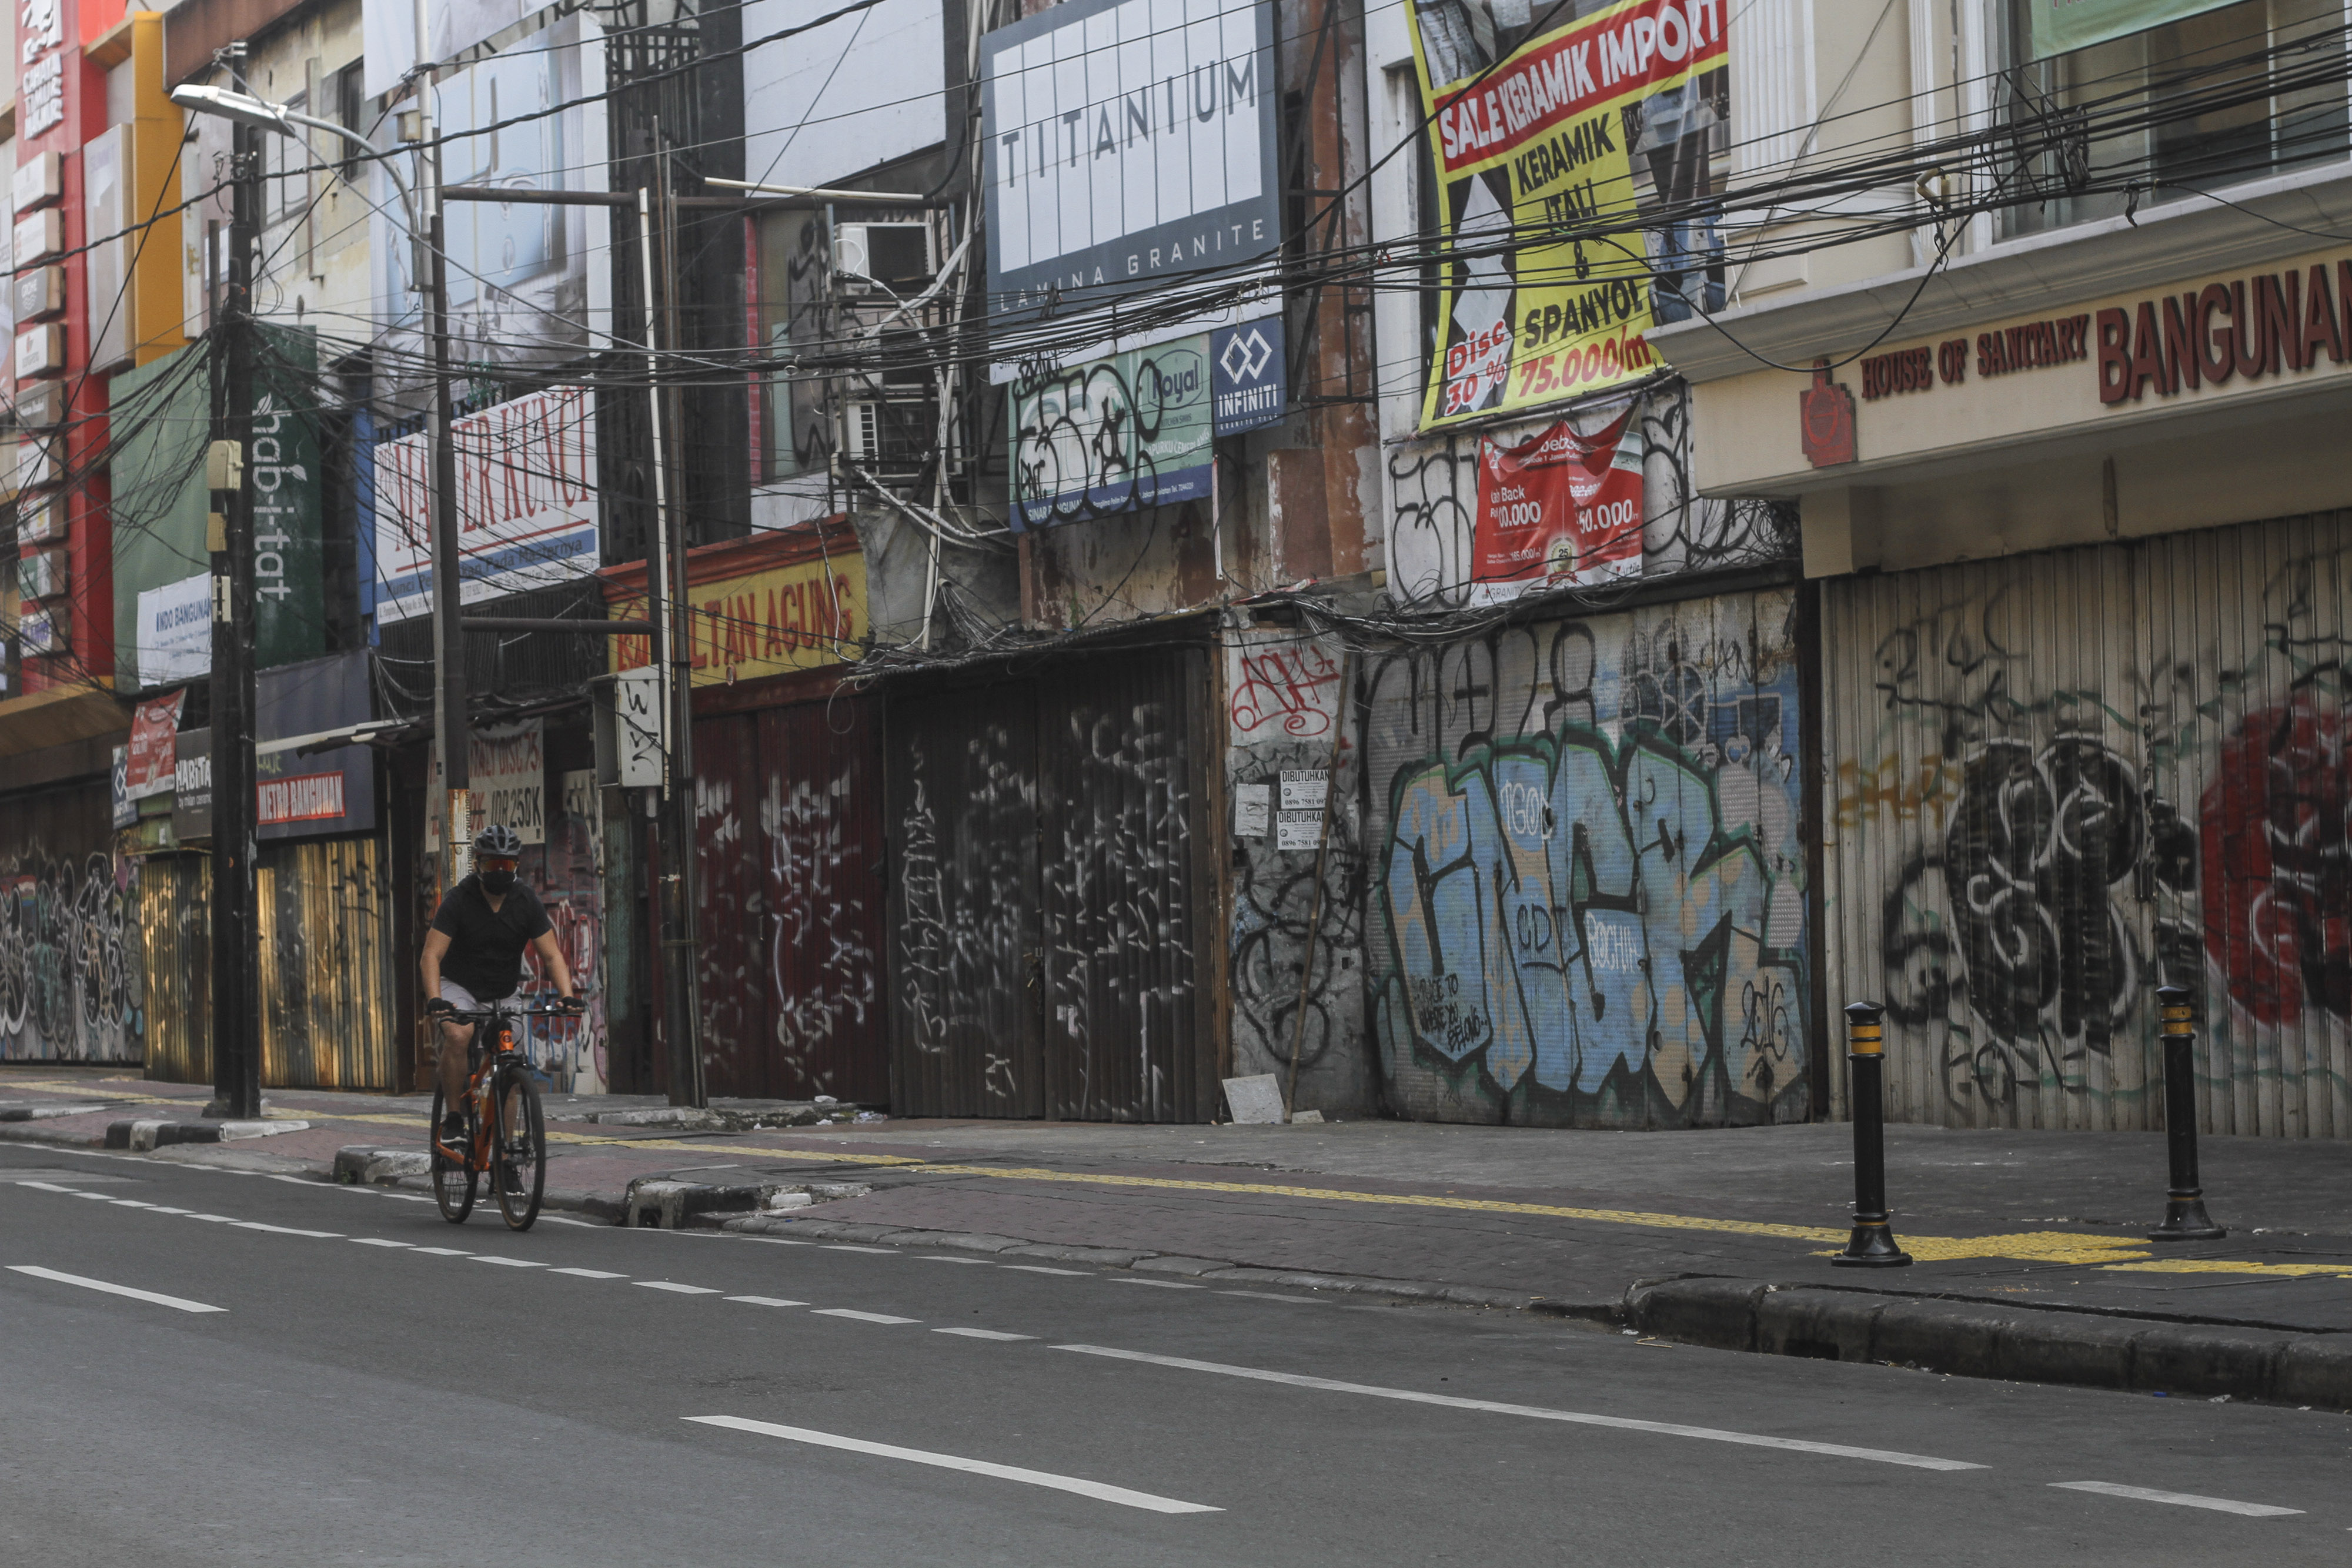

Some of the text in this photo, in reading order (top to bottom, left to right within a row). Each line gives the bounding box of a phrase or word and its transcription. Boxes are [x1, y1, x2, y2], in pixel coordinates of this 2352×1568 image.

[1440, 0, 1720, 160] SALE KERAMIK IMPORT
[1002, 48, 1255, 188] TITANIUM
[1514, 112, 1616, 196] KERAMIK
[999, 266, 1105, 312] LAMINA
[1127, 219, 1264, 275] GRANITE
[1524, 279, 1645, 349] SPANYOL
[1152, 359, 1198, 403] Royal
[1860, 346, 1933, 401] HOUSE
[1937, 338, 1967, 385] OF
[1977, 313, 2091, 377] SANITARY
[1219, 383, 1277, 417] INFINITI
[1220, 419, 1253, 430] GRANITE
[1445, 375, 1479, 416] 30
[501, 386, 590, 522] KUNCI
[1501, 485, 1525, 502] Back
[764, 573, 853, 658] AGUNG
[258, 775, 343, 821] METRO BANGUNAN
[510, 785, 542, 828] 250K
